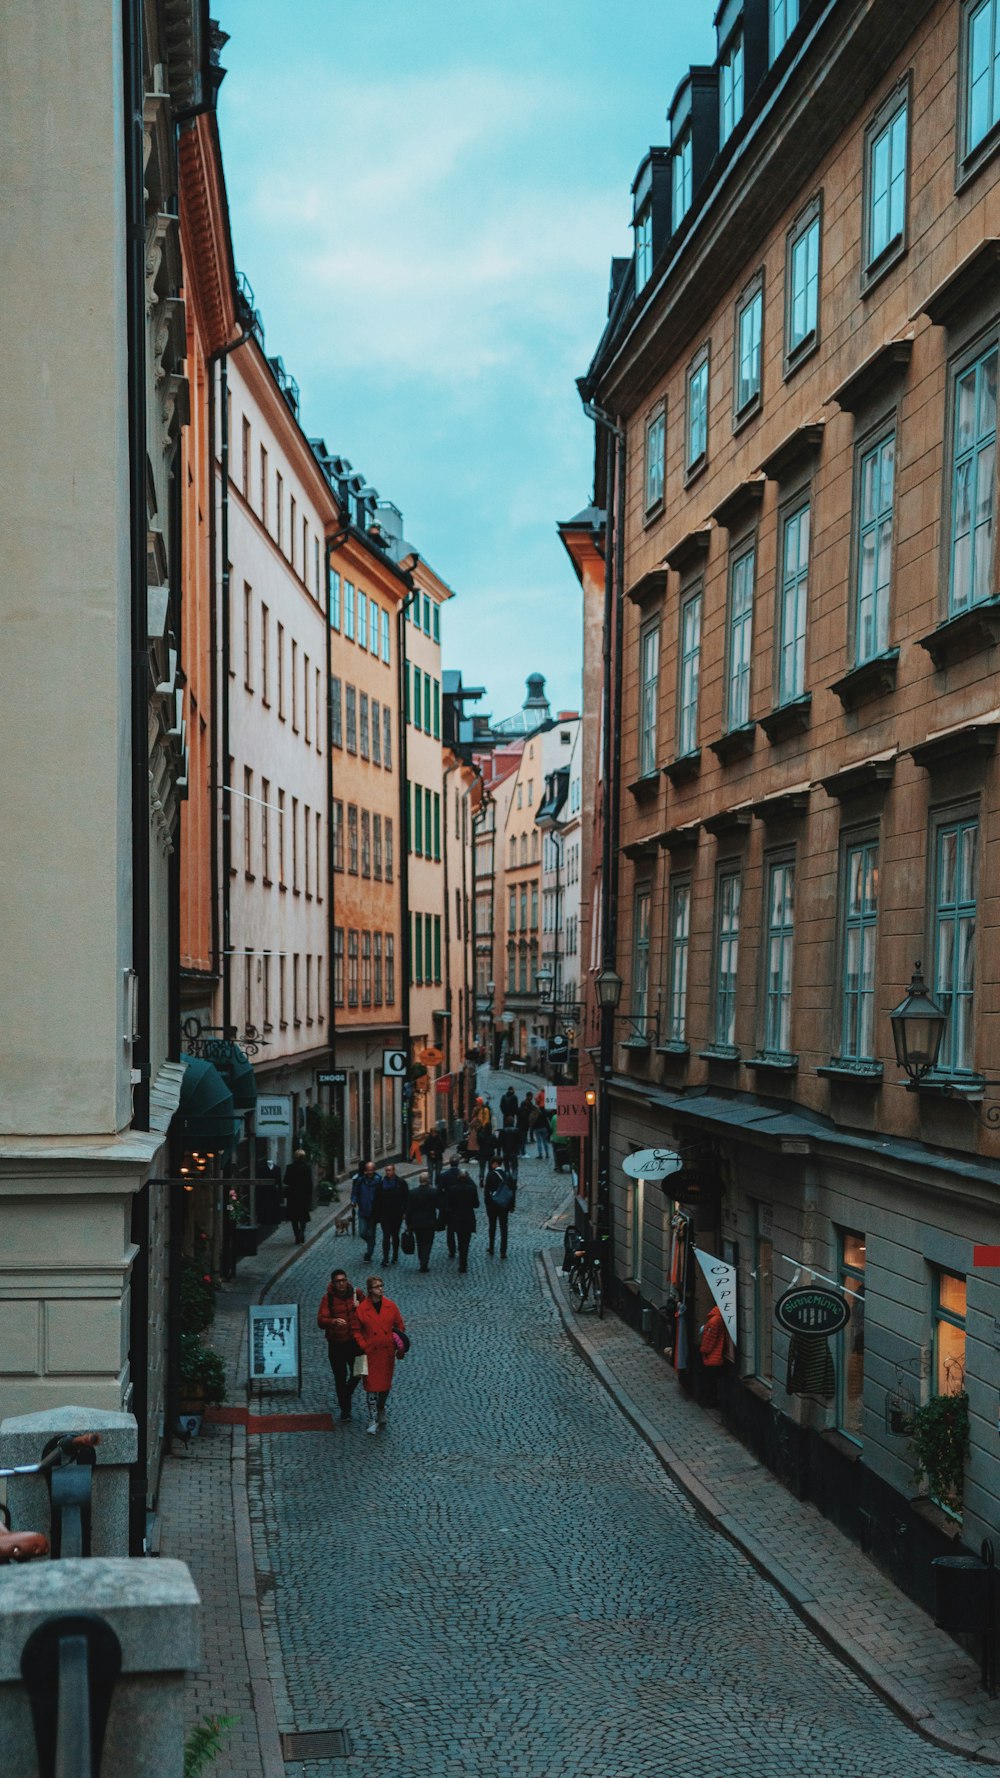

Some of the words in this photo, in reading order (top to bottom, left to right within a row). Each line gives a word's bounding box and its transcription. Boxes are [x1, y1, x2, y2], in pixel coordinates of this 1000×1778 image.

[260, 1105, 282, 1116] ESTER
[557, 1104, 588, 1116] DIVA
[711, 1265, 735, 1324] ÖPPET
